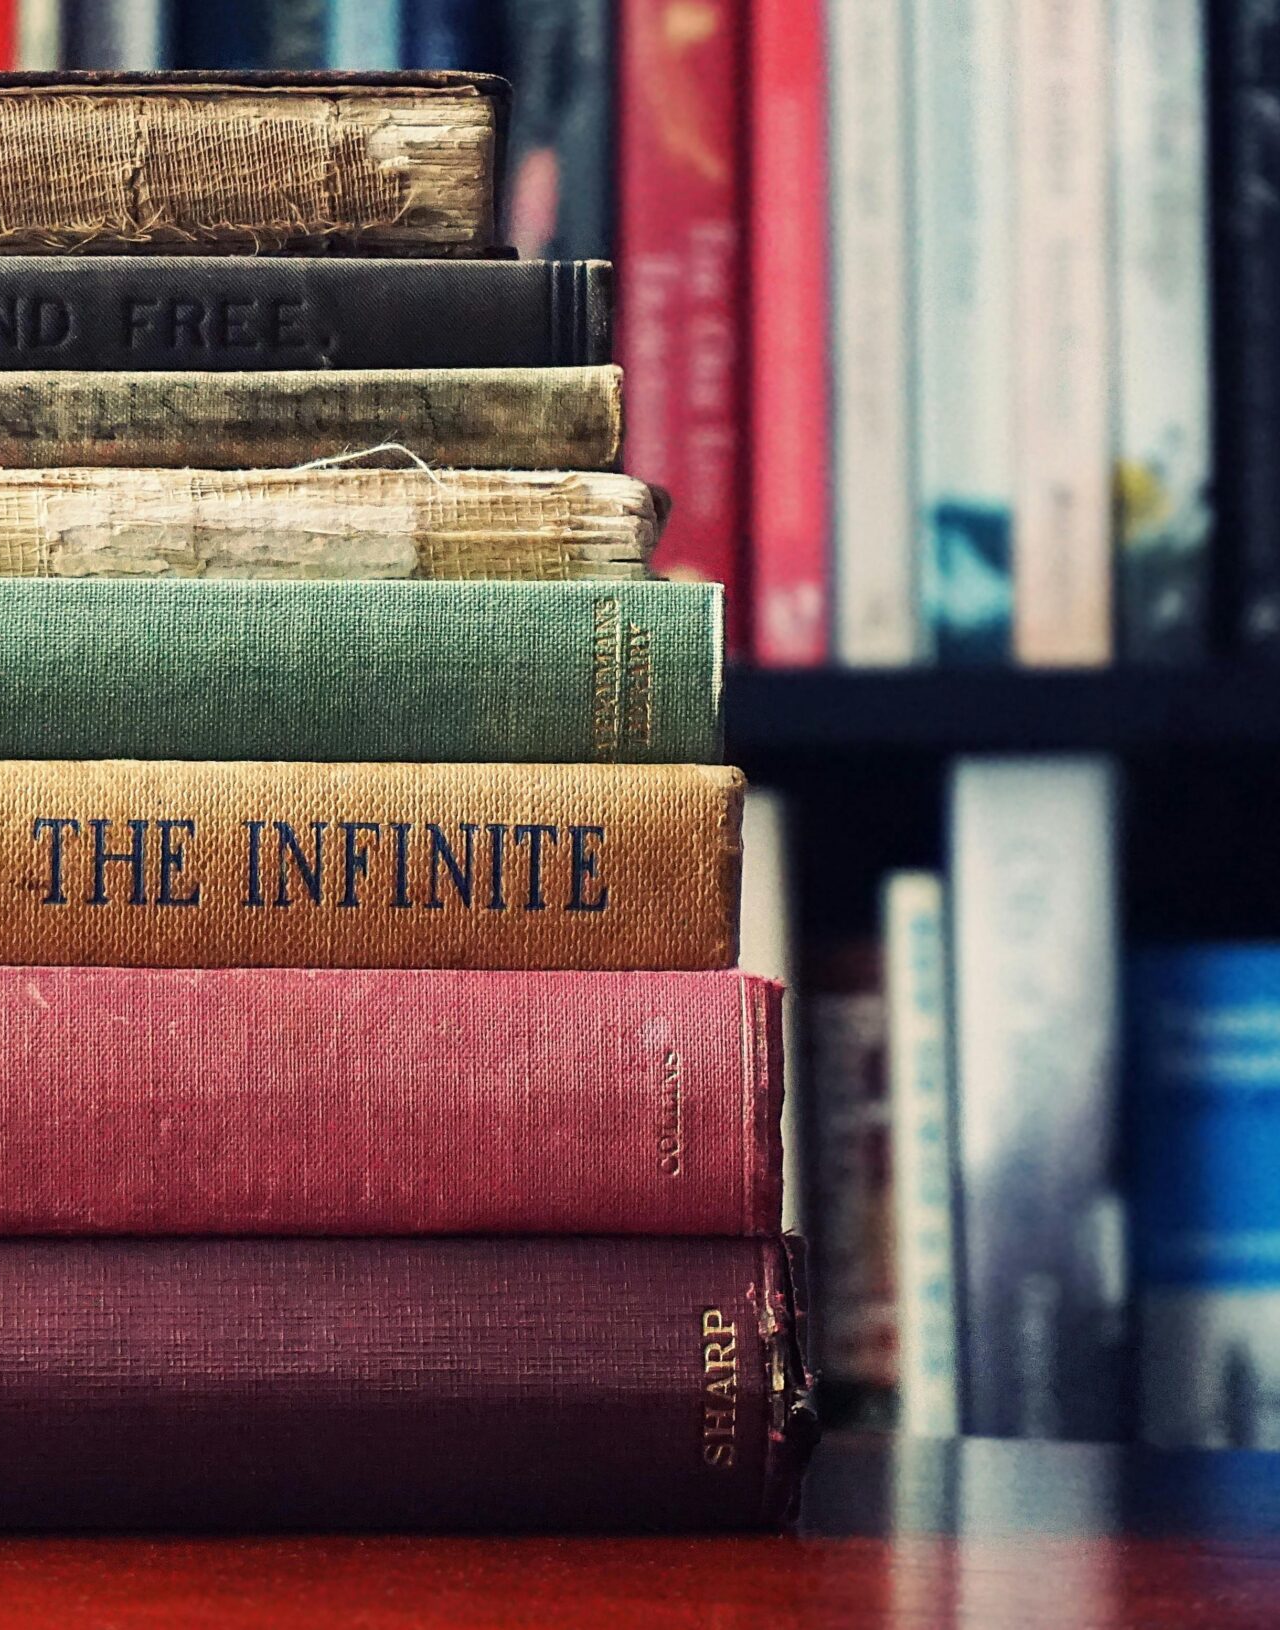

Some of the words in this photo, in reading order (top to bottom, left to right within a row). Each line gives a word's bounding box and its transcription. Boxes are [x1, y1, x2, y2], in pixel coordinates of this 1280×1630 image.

[33, 818, 200, 907] THE
[243, 820, 610, 912] INFINITE
[703, 1308, 737, 1466] SHARP
